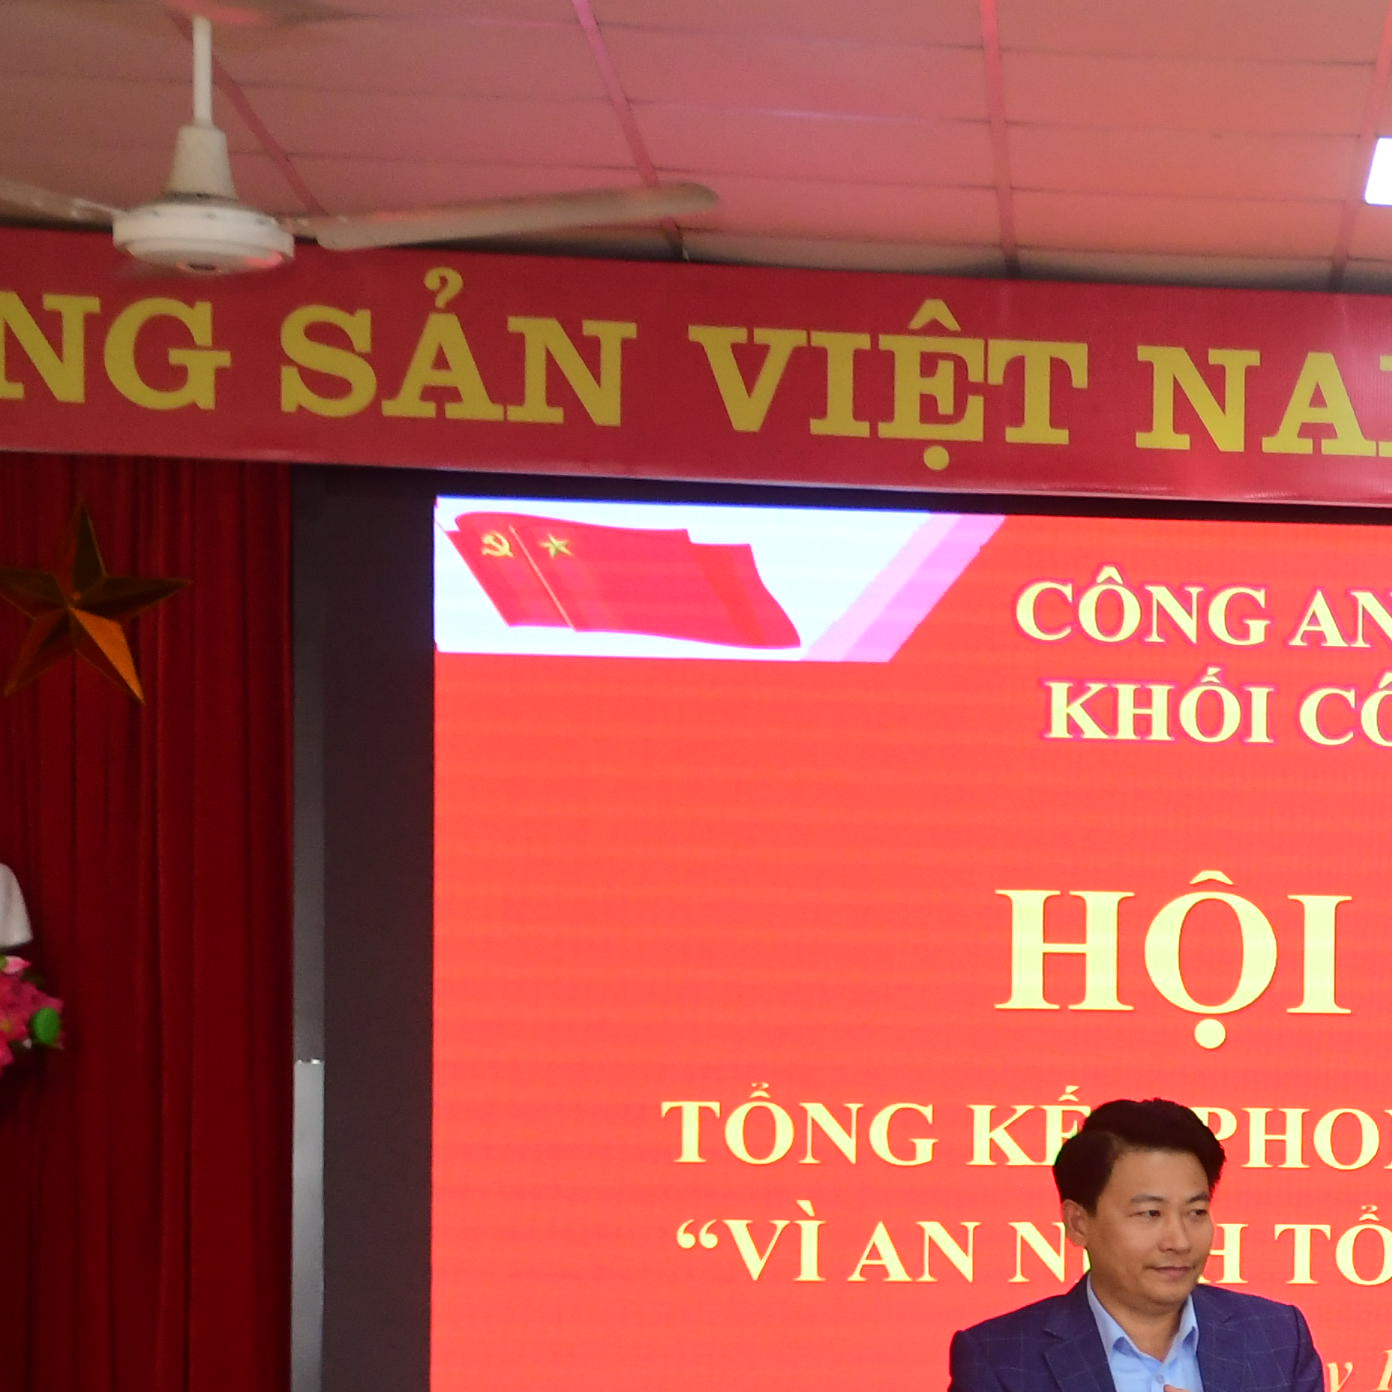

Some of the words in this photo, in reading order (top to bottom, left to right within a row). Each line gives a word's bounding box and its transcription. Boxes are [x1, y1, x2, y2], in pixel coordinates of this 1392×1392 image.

[0, 292, 230, 409] NG
[280, 266, 637, 426] SẢN
[689, 299, 1088, 470] VIỆT
[1015, 565, 1271, 646] CÔNG
[1046, 660, 1274, 743] KHỐI
[994, 868, 1353, 1049] HỘI
[661, 1082, 939, 1166] TỔNG
[966, 1085, 1092, 1167] KẾ
[676, 1199, 825, 1282] “VÌ
[847, 1221, 981, 1283] AN
[1008, 1221, 1249, 1285] NH
